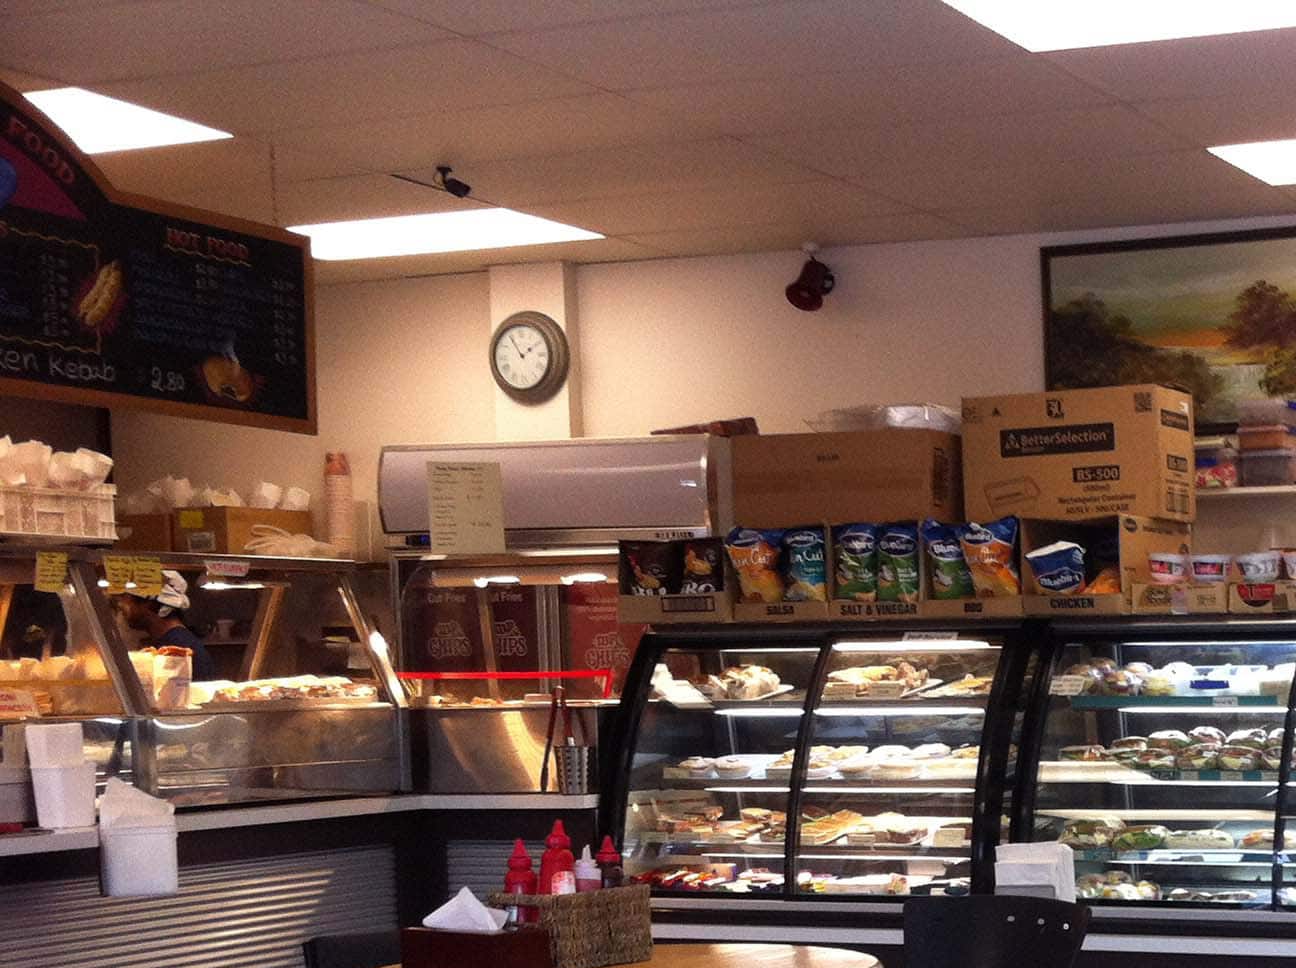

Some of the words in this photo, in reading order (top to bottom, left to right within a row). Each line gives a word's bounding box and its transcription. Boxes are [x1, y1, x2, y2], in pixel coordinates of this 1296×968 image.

[1020, 430, 1107, 448] BetterSelection
[840, 603, 862, 616] SALT
[875, 603, 918, 616] VINEGAR
[1050, 598, 1094, 609] CHICKEN
